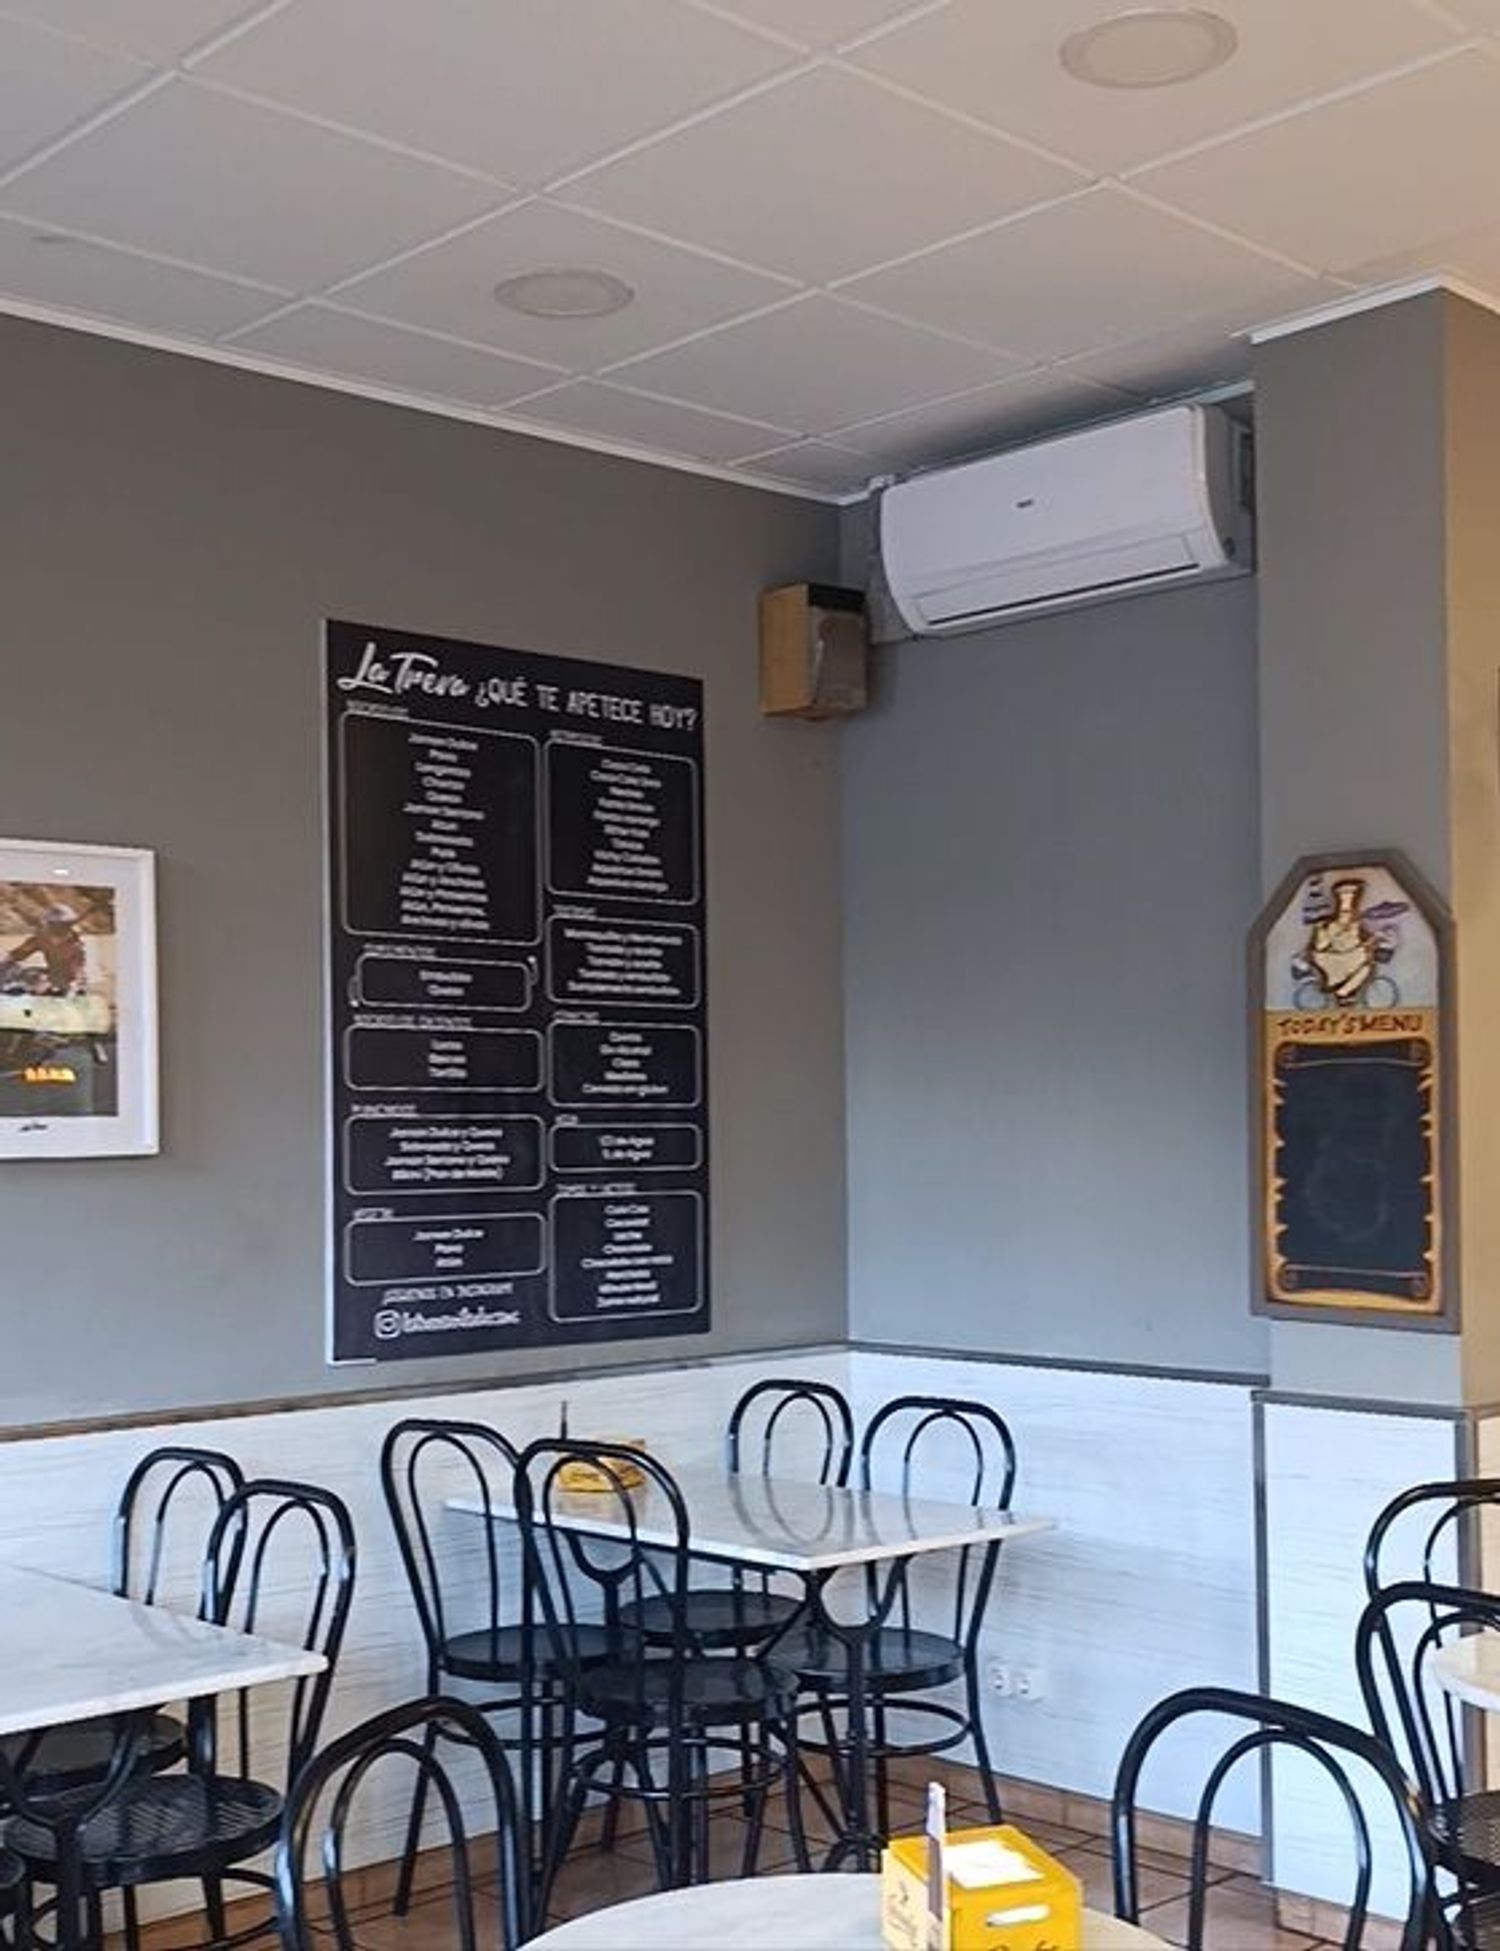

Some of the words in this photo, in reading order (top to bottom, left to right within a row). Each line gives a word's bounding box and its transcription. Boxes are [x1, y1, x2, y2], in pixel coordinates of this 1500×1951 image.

[536, 683, 560, 713] TE
[567, 691, 643, 725] APETECE
[1360, 1013, 1423, 1032] MENU
